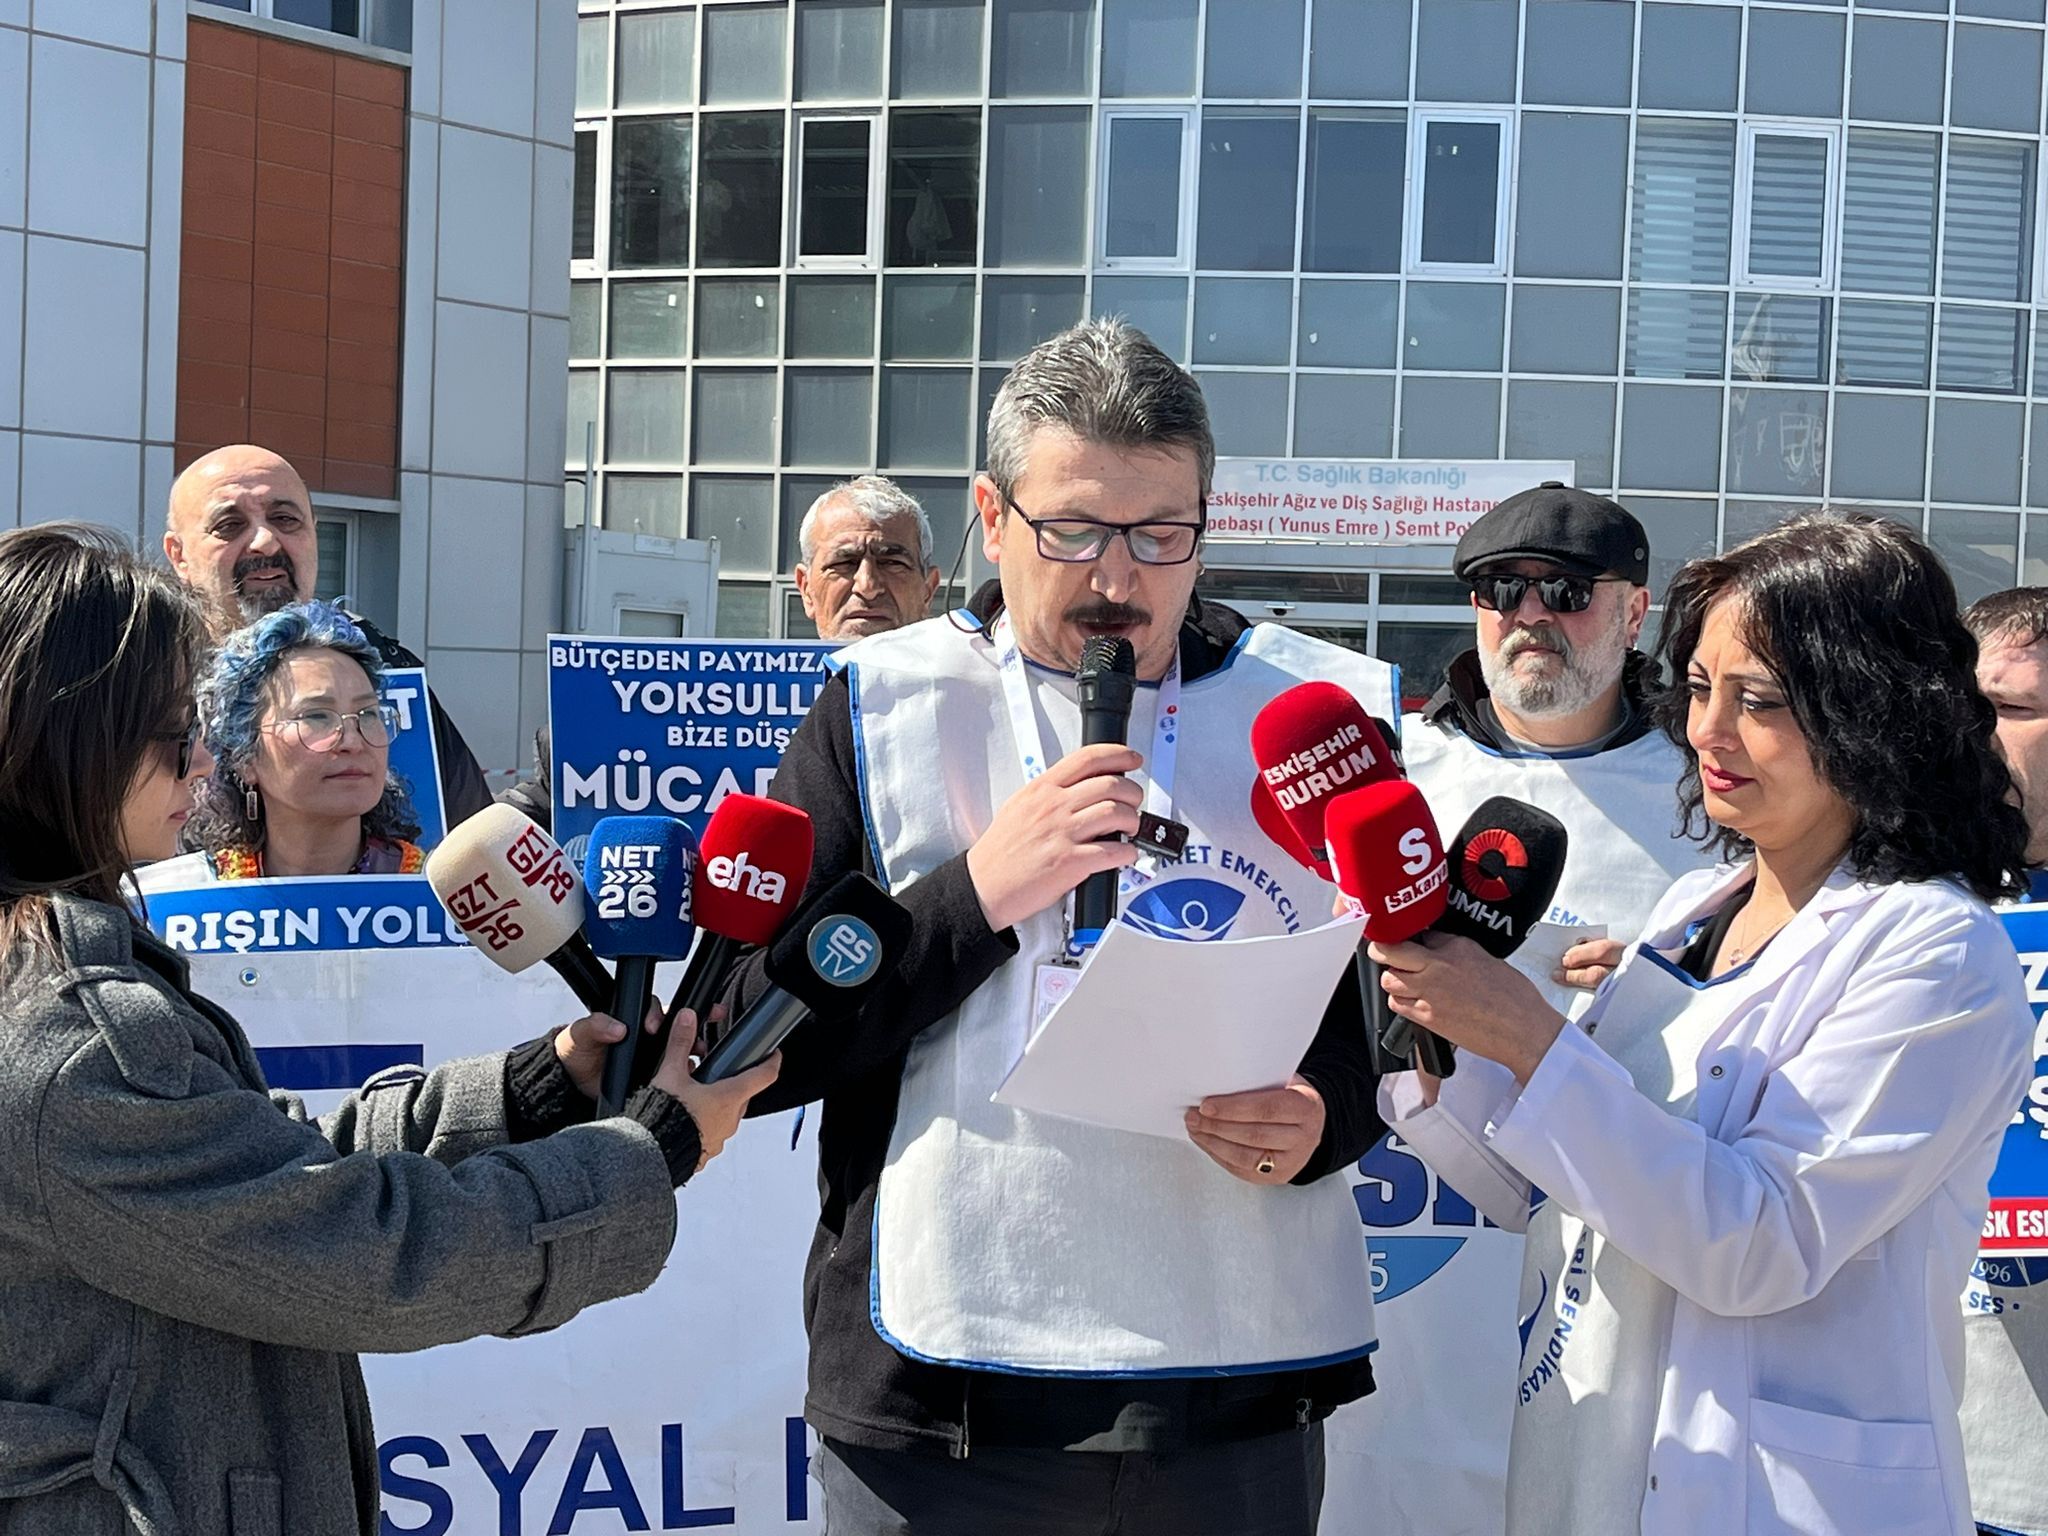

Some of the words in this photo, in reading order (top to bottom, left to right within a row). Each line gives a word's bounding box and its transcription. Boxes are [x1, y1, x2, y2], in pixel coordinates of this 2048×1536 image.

[1297, 464, 1362, 488] Sağlık
[1368, 466, 1467, 491] Bakanlığı
[1283, 493, 1317, 512] Ağız
[1320, 498, 1338, 510] ve
[1343, 494, 1368, 515] Diş
[1372, 495, 1428, 515] Sağlığı
[1207, 516, 1263, 535] pebaşı
[1279, 516, 1330, 533] Yunus
[1335, 518, 1378, 536] Emre
[1395, 520, 1441, 537] Semt
[551, 641, 690, 676] BÜTÇEDEN
[667, 719, 728, 748] BİZE
[736, 721, 797, 754] DÜŞ
[1262, 723, 1363, 787] ESKİŞEHİR
[1274, 744, 1377, 812] DURUM
[505, 825, 550, 877] GZT
[600, 845, 661, 870] NET
[446, 871, 500, 922] GZT
[539, 866, 575, 905] 26
[706, 851, 787, 905] eha
[1219, 849, 1301, 935] EMEKÇİL
[598, 884, 658, 919] 26
[1446, 884, 1514, 937] UMHA
[165, 906, 319, 953] RIŞIN
[477, 919, 526, 952] 26
[1981, 1210, 2011, 1238] SK
[2016, 1209, 2048, 1238] ES
[1368, 1251, 1390, 1295] 5
[1570, 1231, 1587, 1275] Rİ
[1968, 1291, 2005, 1315] SES
[378, 1420, 736, 1536] SYAL
